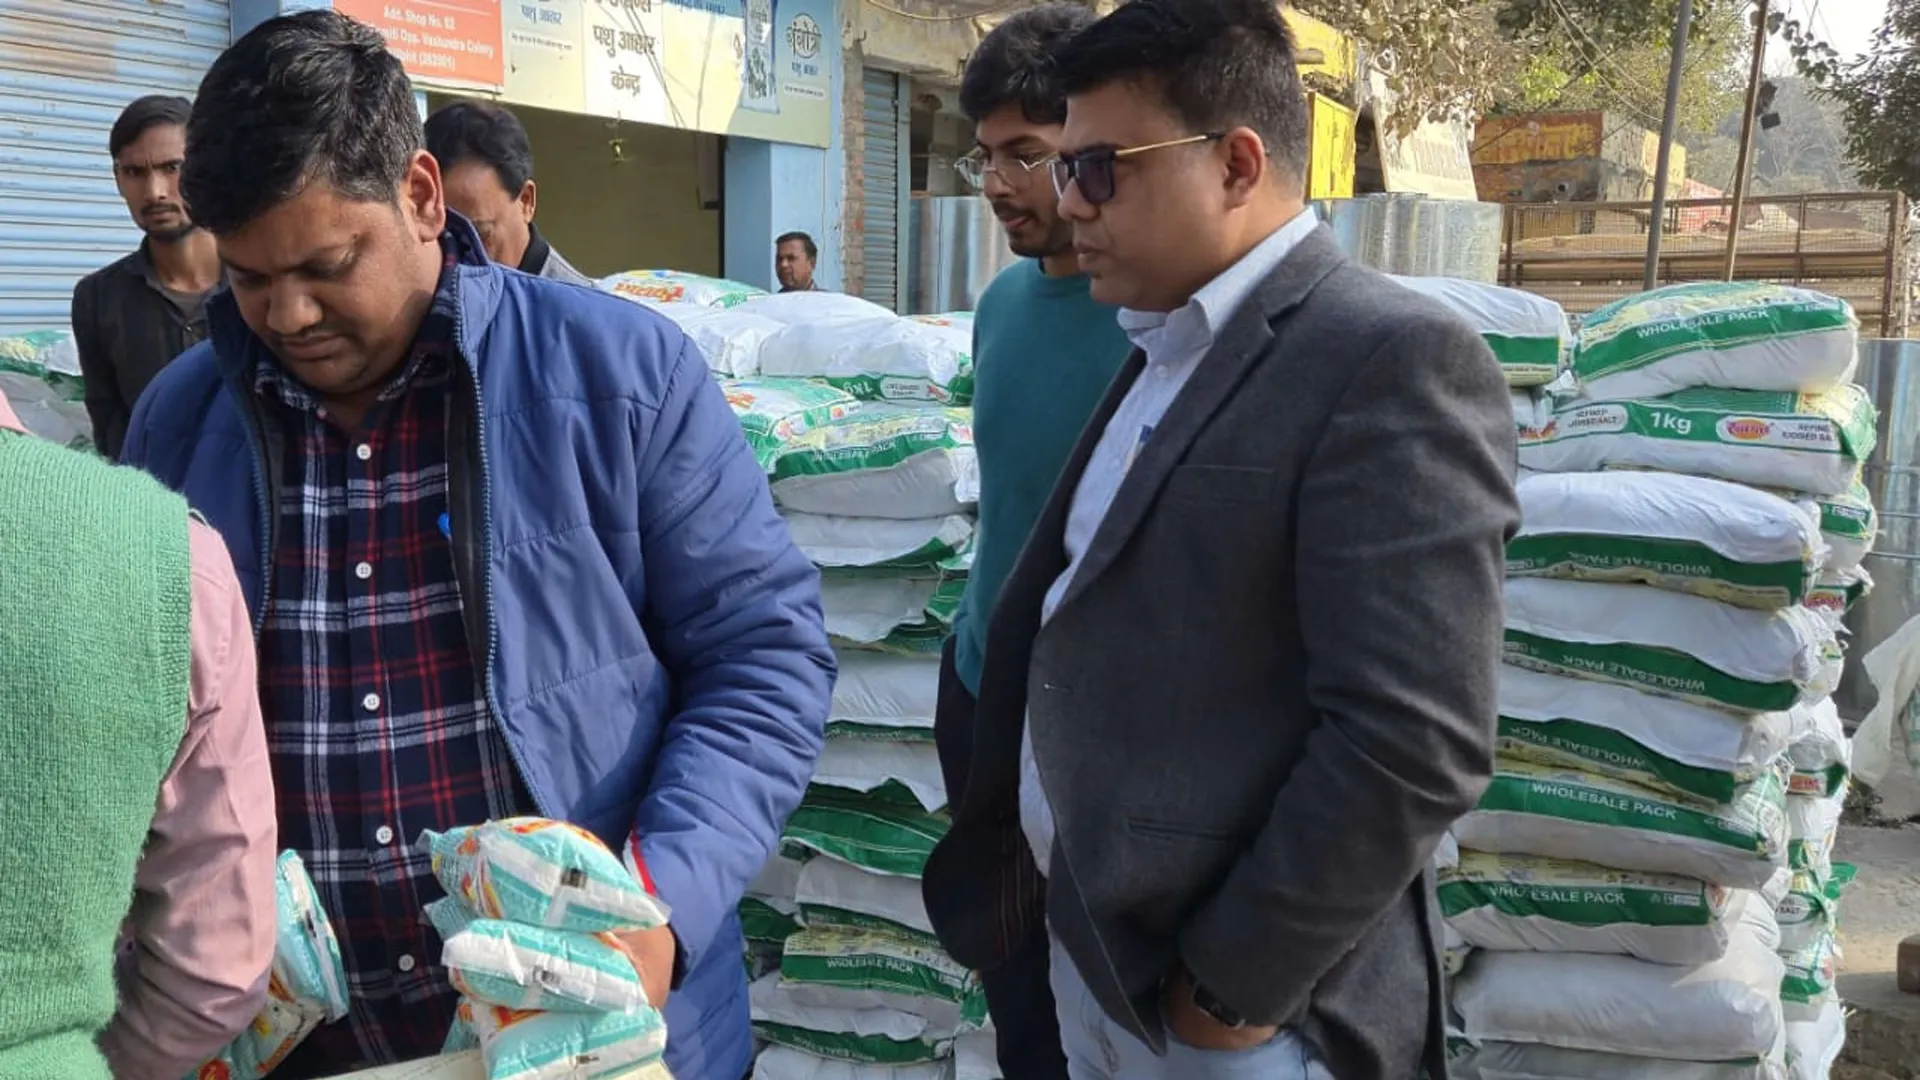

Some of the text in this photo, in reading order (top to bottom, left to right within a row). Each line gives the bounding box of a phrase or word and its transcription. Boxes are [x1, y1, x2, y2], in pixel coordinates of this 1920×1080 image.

[405, 10, 427, 28] Shop
[428, 13, 443, 29] No.
[593, 25, 616, 58] पशु
[618, 30, 656, 56] आहार
[611, 64, 642, 98] केन्द्र
[1636, 309, 1770, 339] WHOLESALE PACK
[1650, 411, 1692, 436] 1kg
[1562, 654, 1706, 692] WHOLESALE PACK
[1509, 725, 1645, 768] WHOLESALE PACK
[1531, 781, 1678, 821] WHOLESALE PACK
[1488, 886, 1626, 905] WHOESALE PACK
